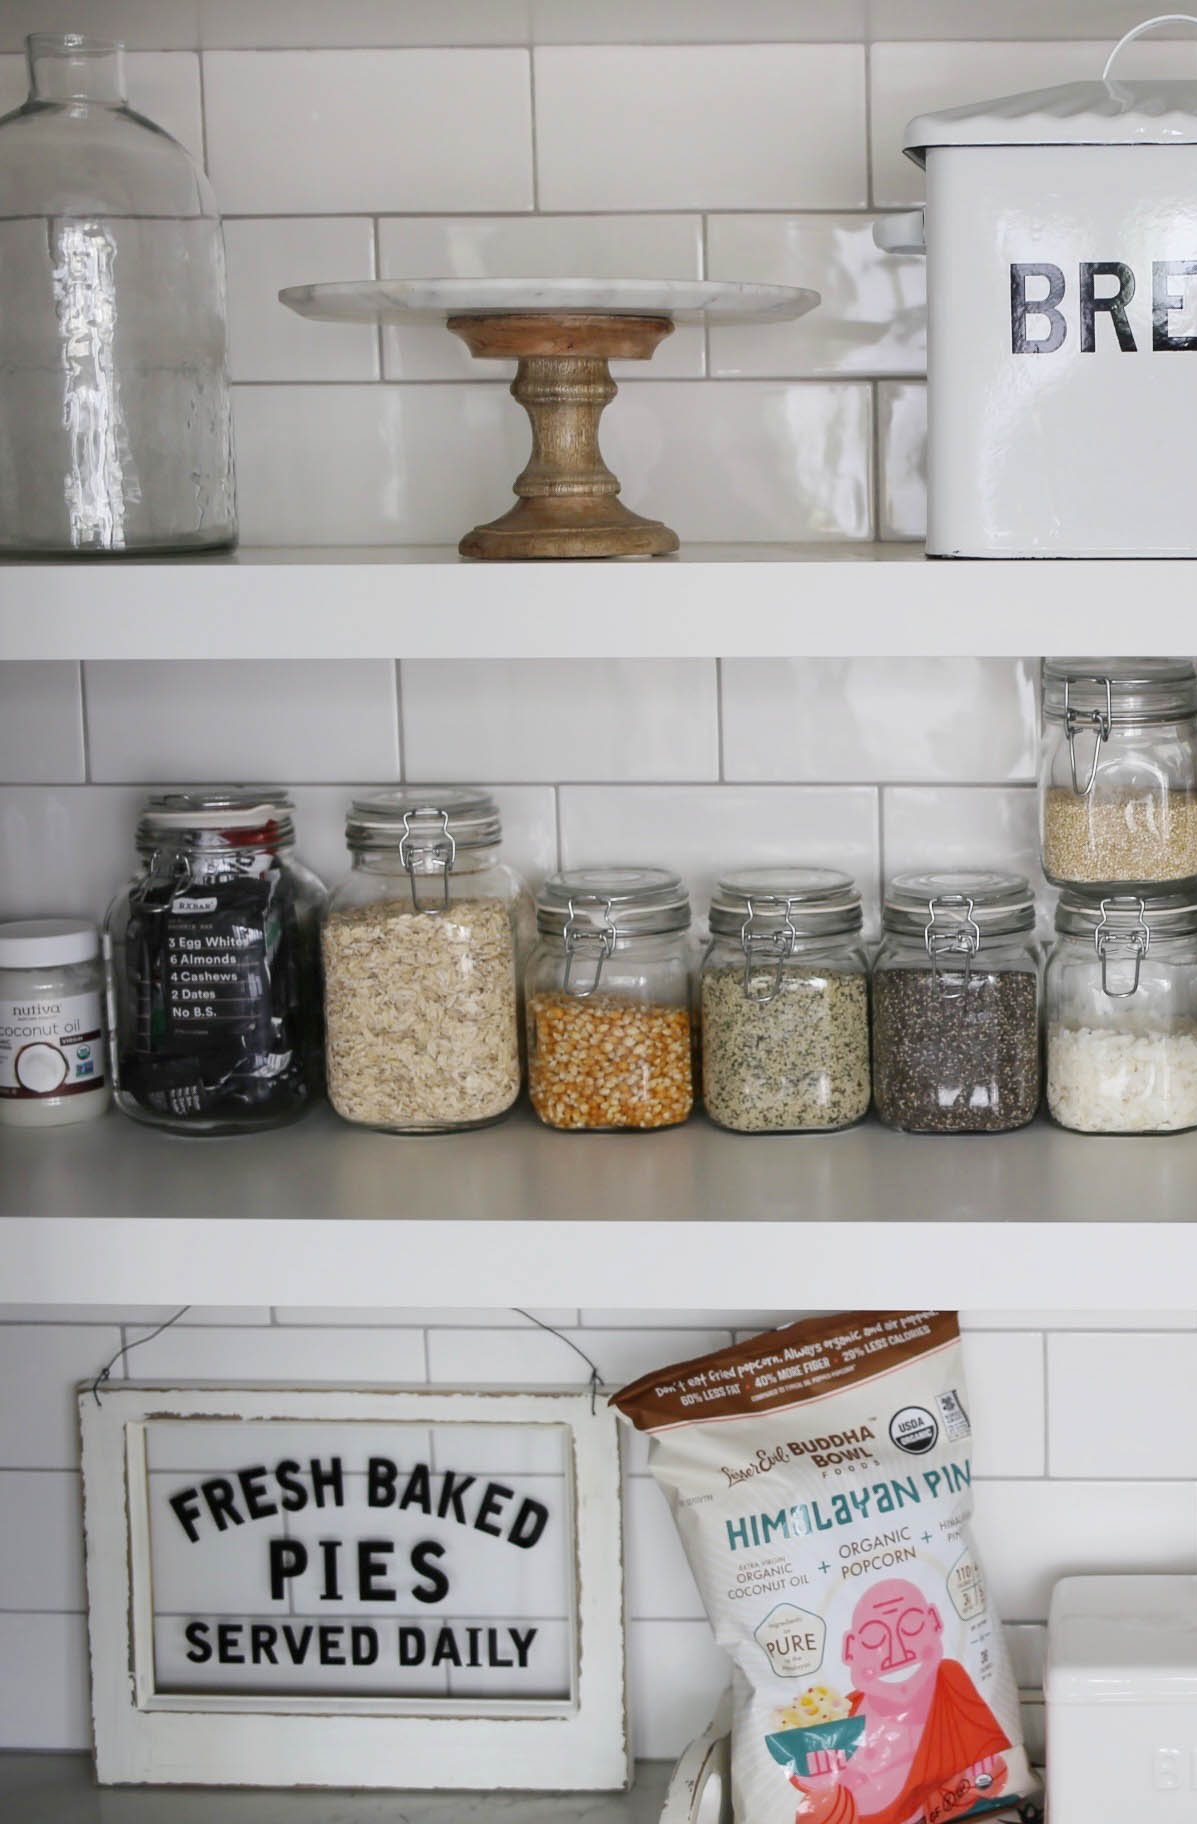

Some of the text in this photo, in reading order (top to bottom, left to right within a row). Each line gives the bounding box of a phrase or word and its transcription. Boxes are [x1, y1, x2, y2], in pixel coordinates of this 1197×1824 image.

[168, 935, 250, 950] 3 Egg Whites
[169, 953, 237, 965] 6 Almonds
[170, 970, 238, 982] 4 Cashews
[171, 988, 216, 1000] 2 Dates
[13, 1003, 61, 1016] nutiva
[172, 1006, 217, 1018] No B.S.
[64, 1018, 81, 1033] oil
[687, 1373, 707, 1388] eat
[708, 1365, 736, 1382] fried
[784, 1341, 823, 1362] Always
[823, 1330, 862, 1350] organic
[863, 1322, 883, 1337] and
[884, 1319, 899, 1331] air
[864, 1337, 888, 1353] LESS
[754, 1374, 778, 1388] 40%
[777, 1364, 803, 1381] MORE
[803, 1357, 830, 1374] FIBER
[680, 1392, 703, 1406] 60%
[703, 1386, 726, 1401] LESS
[726, 1383, 741, 1396] FAT
[898, 1417, 925, 1433] USDA
[787, 1425, 875, 1456] BUDDHA
[811, 1447, 873, 1468] BOWL
[169, 1457, 550, 1551] FRESH BAKED
[838, 1526, 912, 1559] ORGANIC
[269, 1539, 451, 1605] PIES
[736, 1563, 793, 1584] ORGANIC
[841, 1546, 917, 1580] POPCORN
[728, 1574, 809, 1600] COCONUT OIL
[184, 1621, 539, 1669] SERVED DAILY
[766, 1633, 817, 1658] PURE
